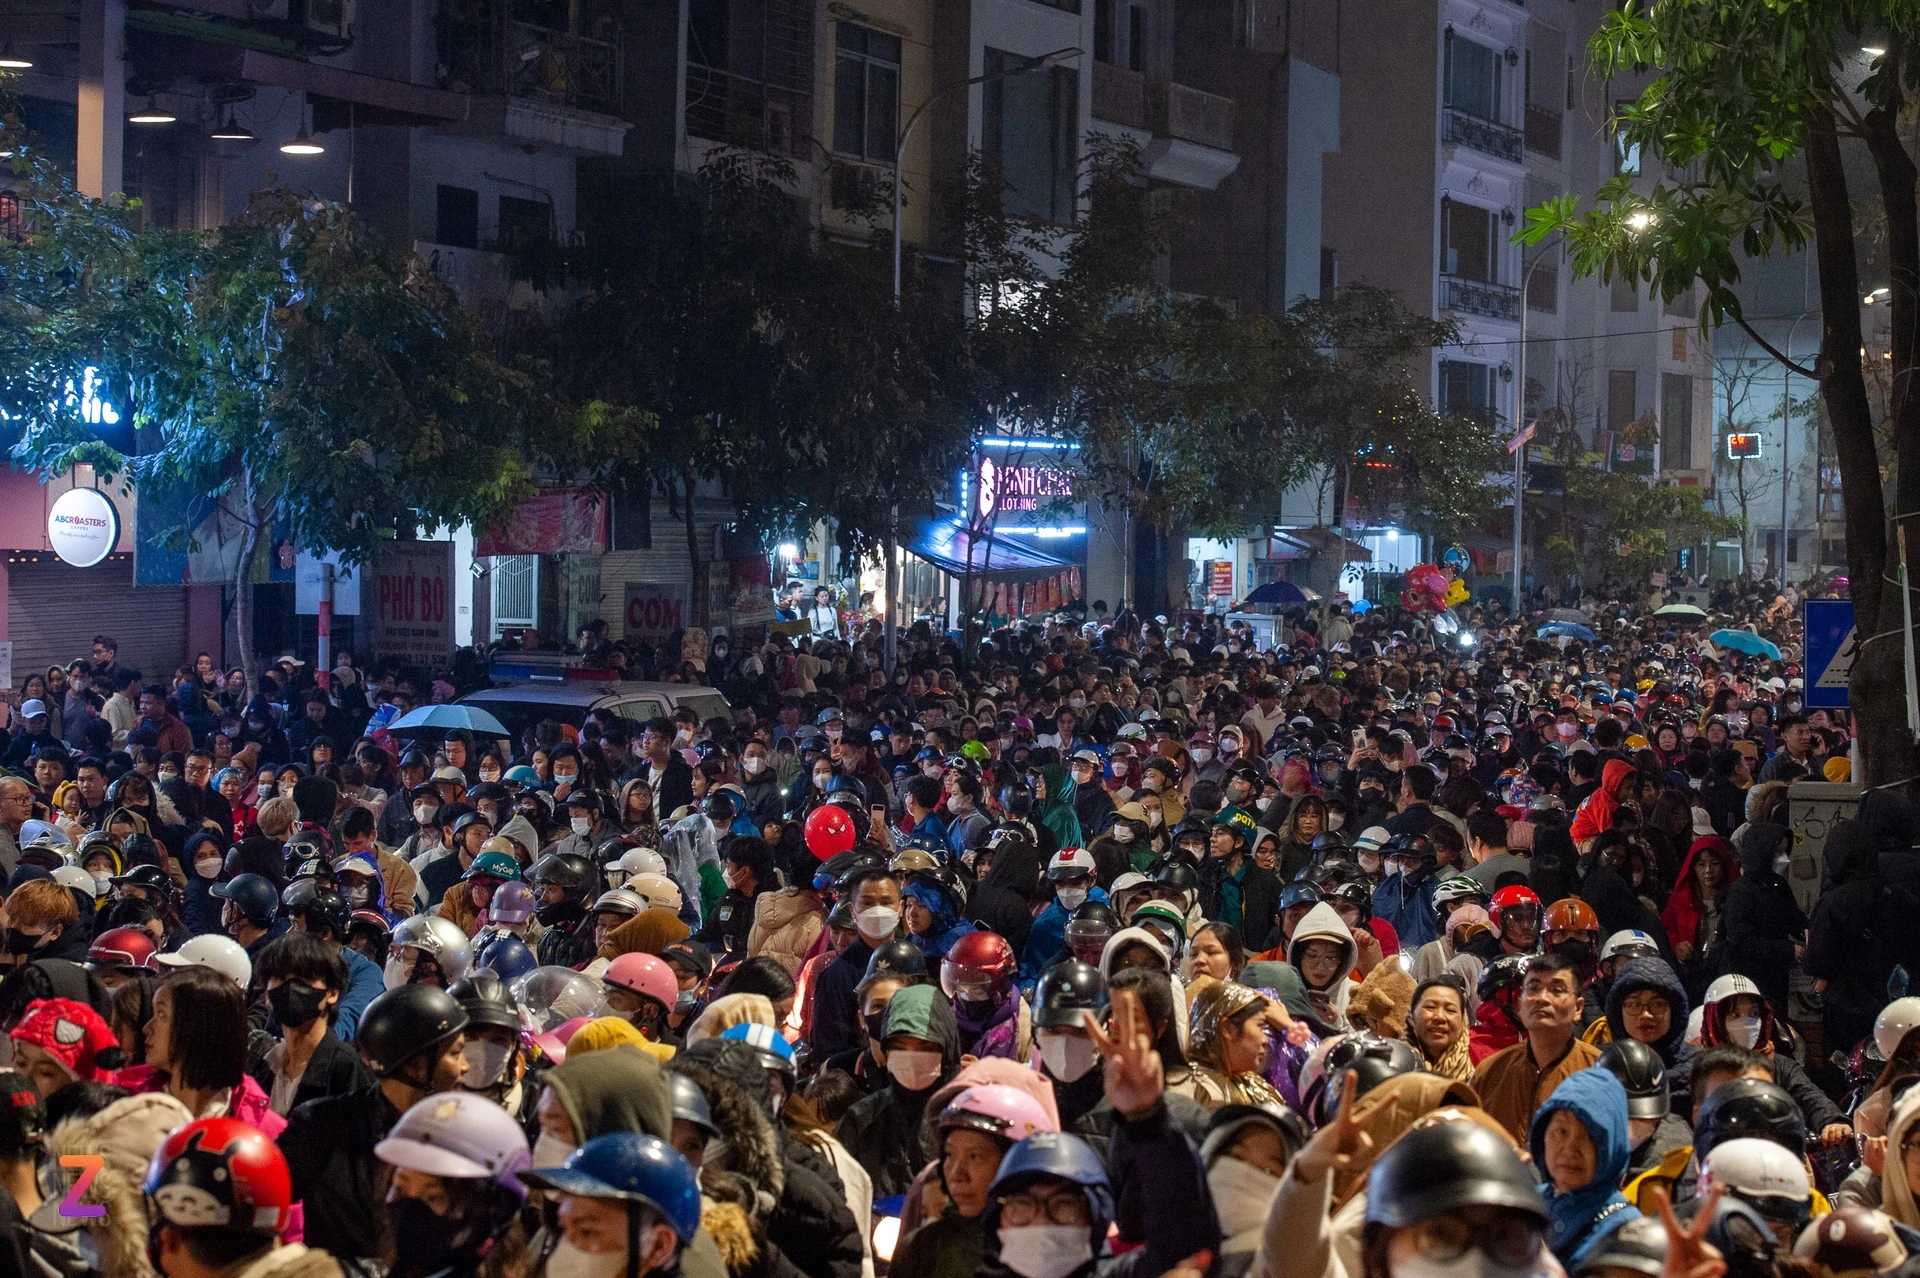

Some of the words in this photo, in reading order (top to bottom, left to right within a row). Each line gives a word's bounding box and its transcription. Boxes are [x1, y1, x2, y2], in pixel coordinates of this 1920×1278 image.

[998, 498, 1037, 511] LOTHING
[55, 515, 106, 527] ABCROASTERS
[379, 560, 415, 621] PHỞ
[421, 565, 445, 622] BÒ
[627, 592, 683, 630] CƠM
